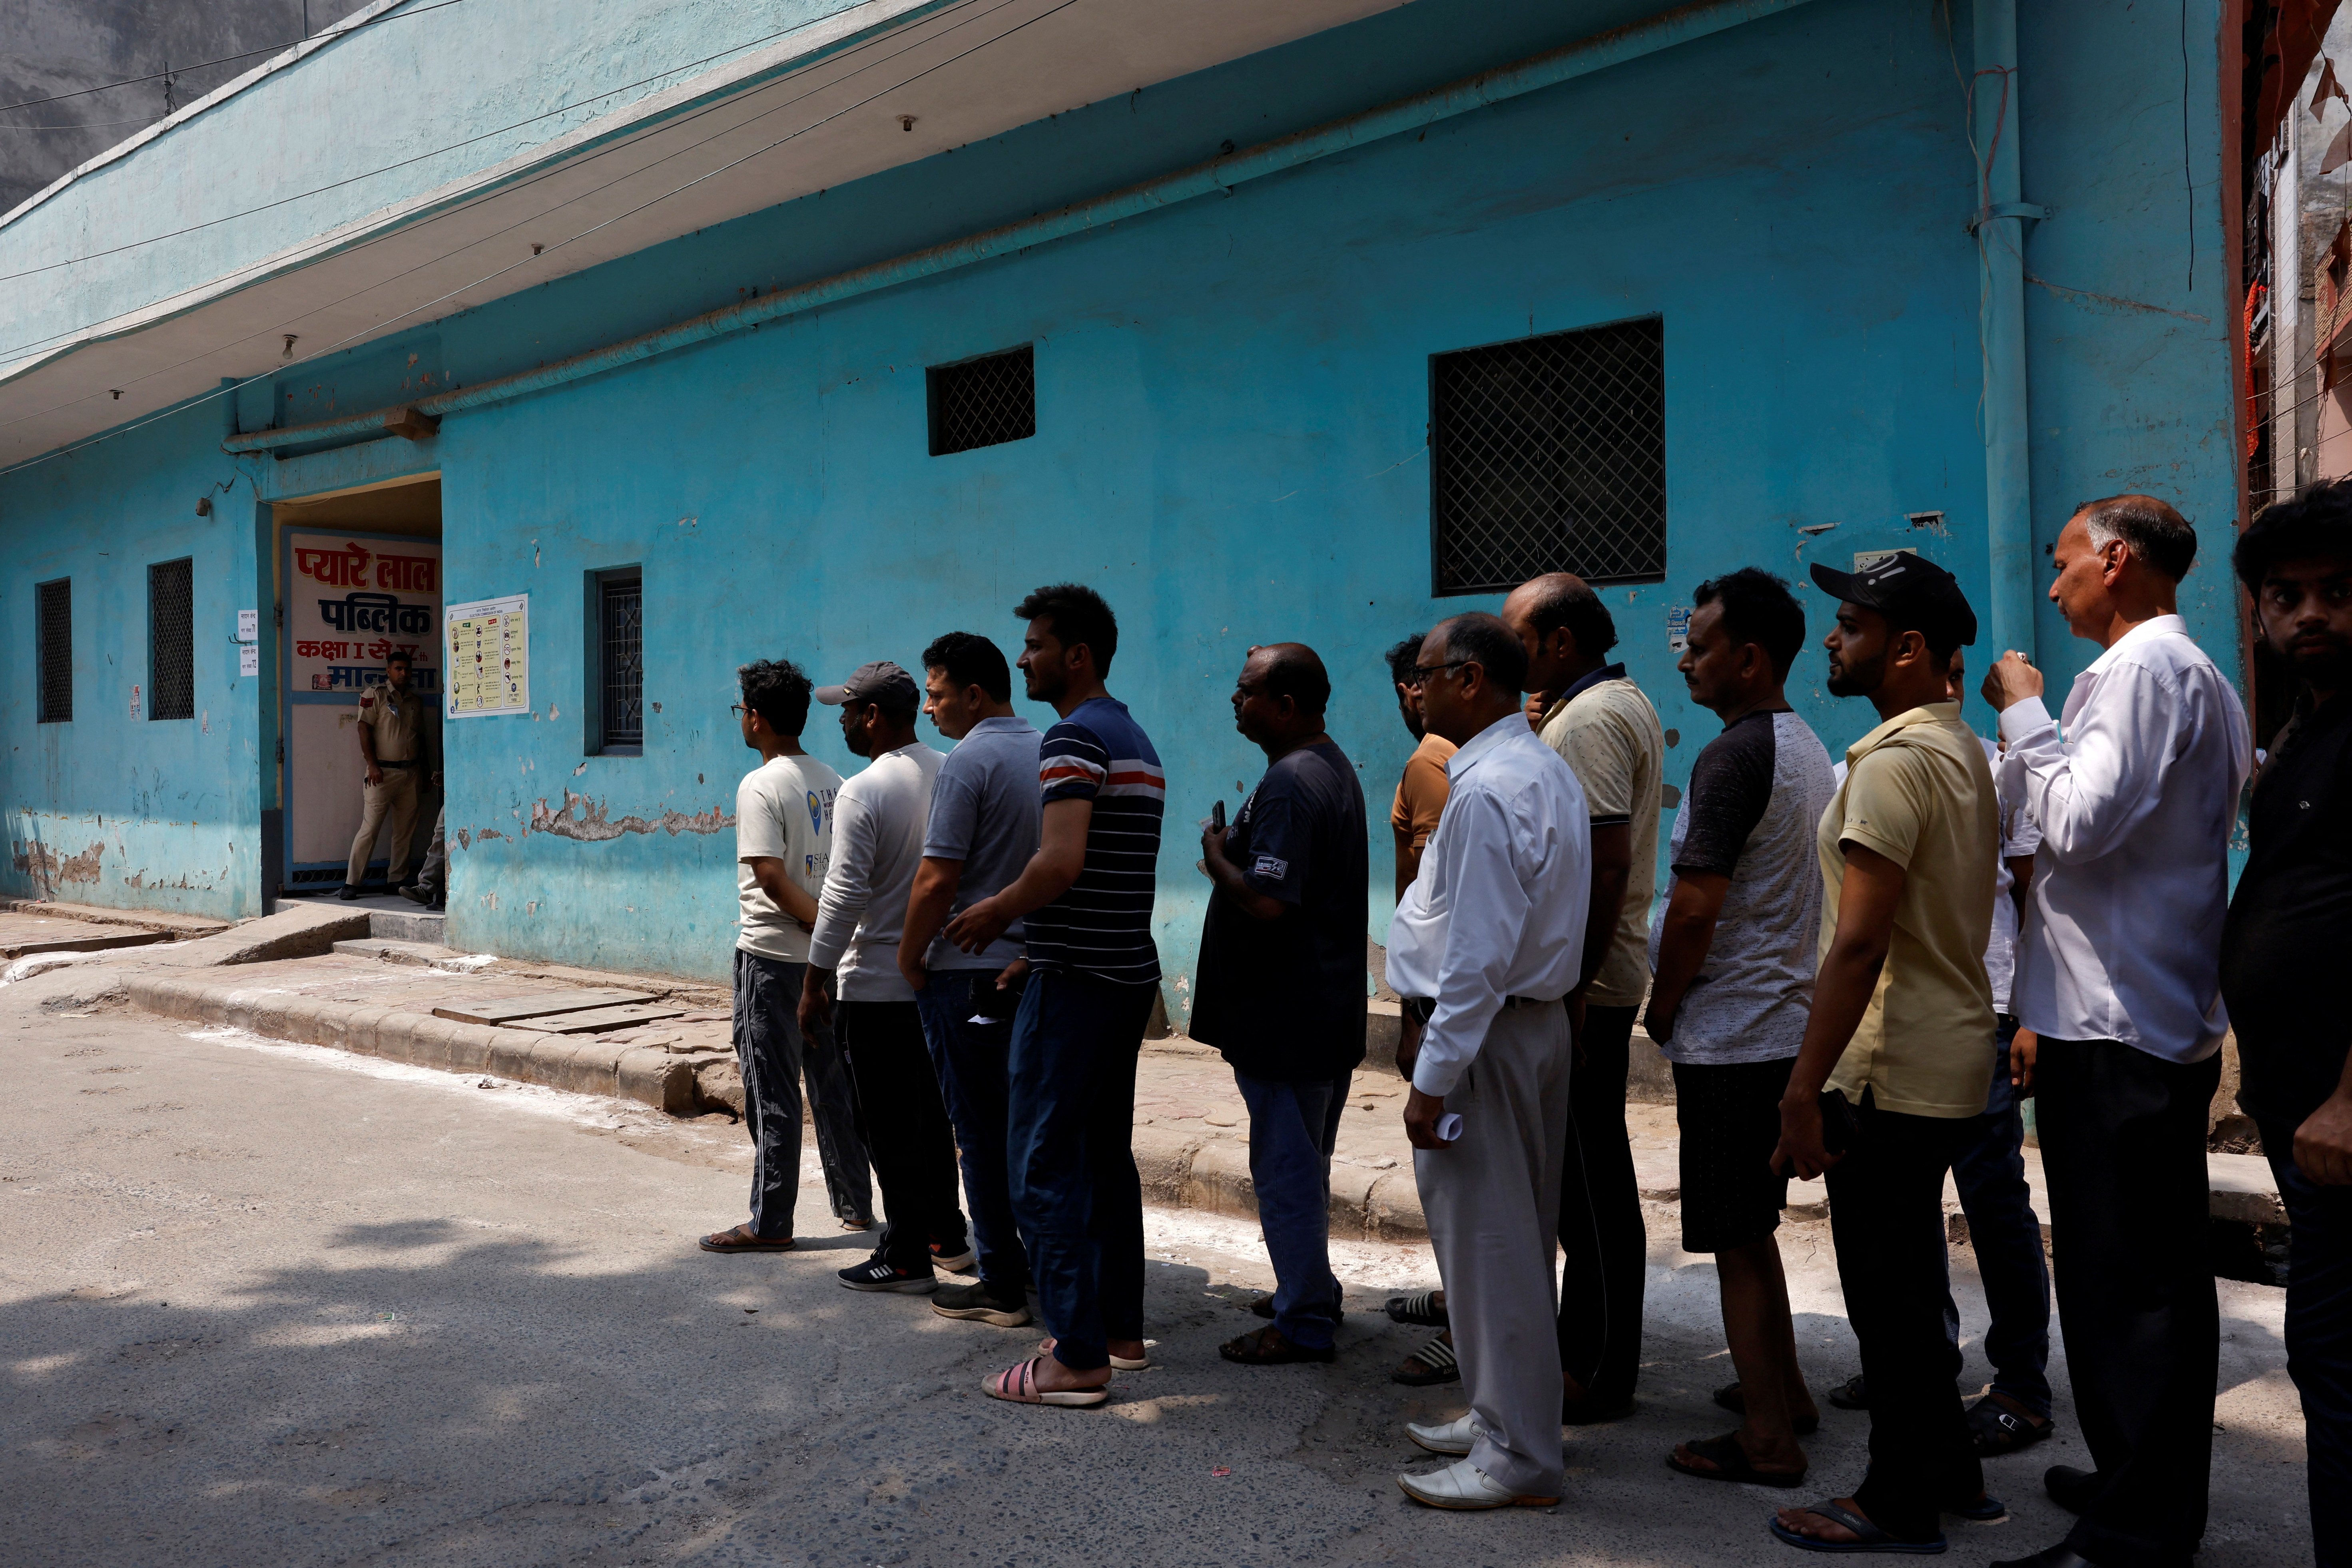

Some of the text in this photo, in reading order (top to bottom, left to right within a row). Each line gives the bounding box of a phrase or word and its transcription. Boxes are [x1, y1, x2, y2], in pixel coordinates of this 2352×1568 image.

[295, 542, 437, 592] प्यारे लाल
[318, 592, 431, 634] पब्लिक
[252, 624, 255, 632] 71
[297, 640, 349, 661] कक्षा
[353, 642, 365, 659] I
[368, 638, 393, 660] से
[252, 659, 256, 668] 72
